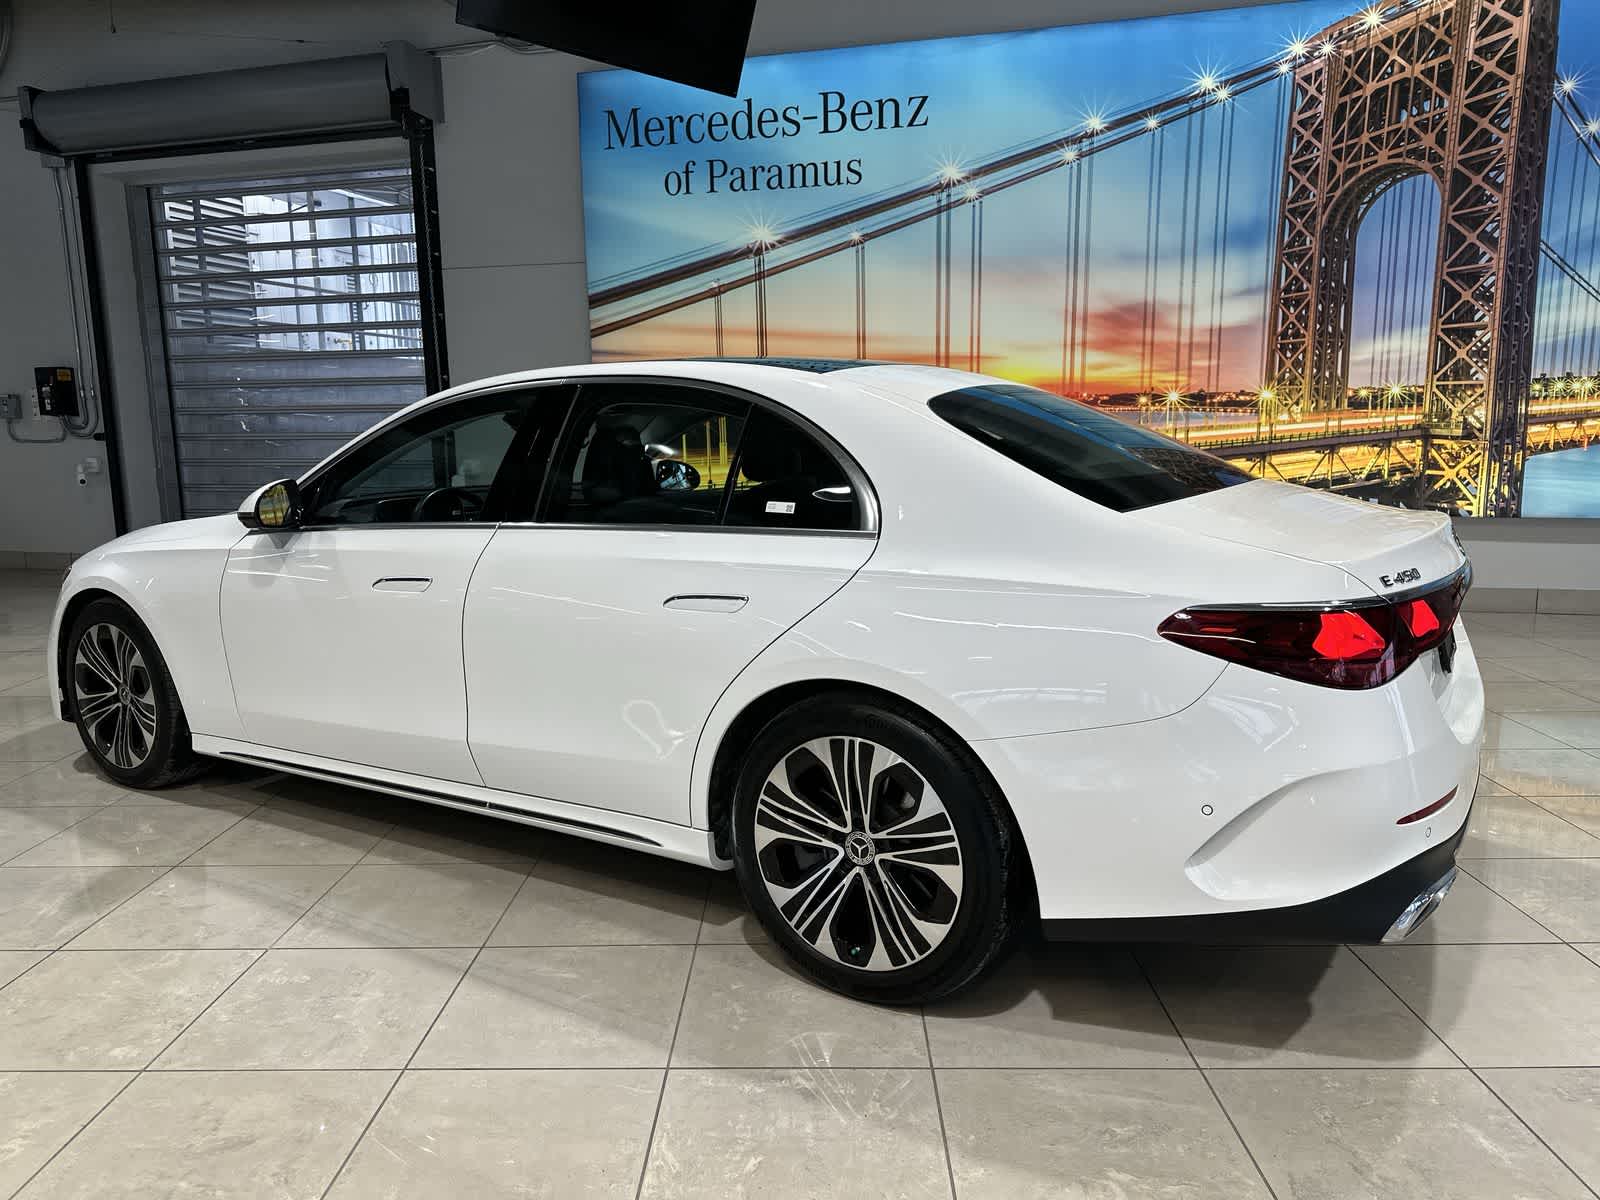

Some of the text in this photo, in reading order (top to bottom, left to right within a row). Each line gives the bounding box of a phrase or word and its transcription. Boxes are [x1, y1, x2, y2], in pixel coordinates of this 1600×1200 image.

[603, 91, 929, 150] Mercedes-Benz
[664, 157, 862, 196] of Paramus
[1379, 567, 1421, 588] E 450
